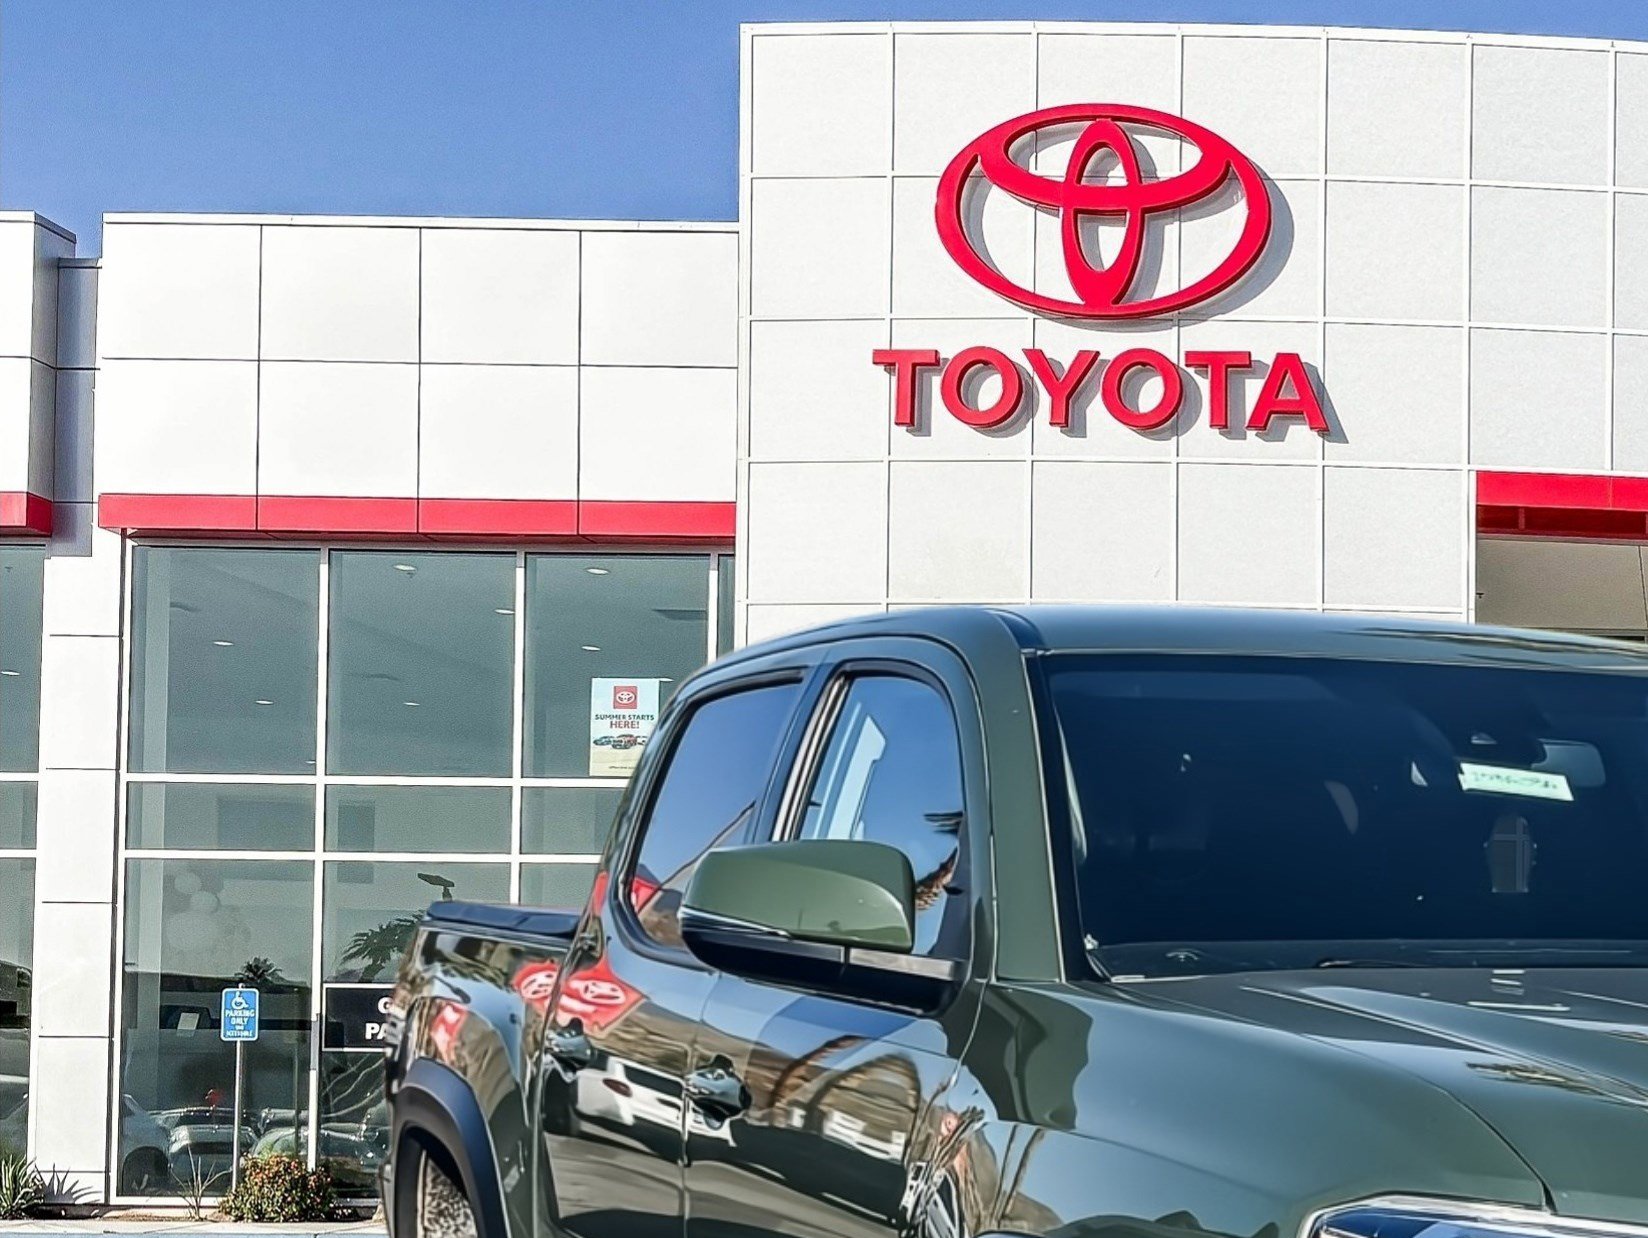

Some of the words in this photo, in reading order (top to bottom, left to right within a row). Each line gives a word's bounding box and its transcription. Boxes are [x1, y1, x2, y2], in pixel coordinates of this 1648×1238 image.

[872, 346, 1330, 433] TOYOTA
[609, 720, 640, 729] HERE!
[225, 1009, 256, 1018] PARKING
